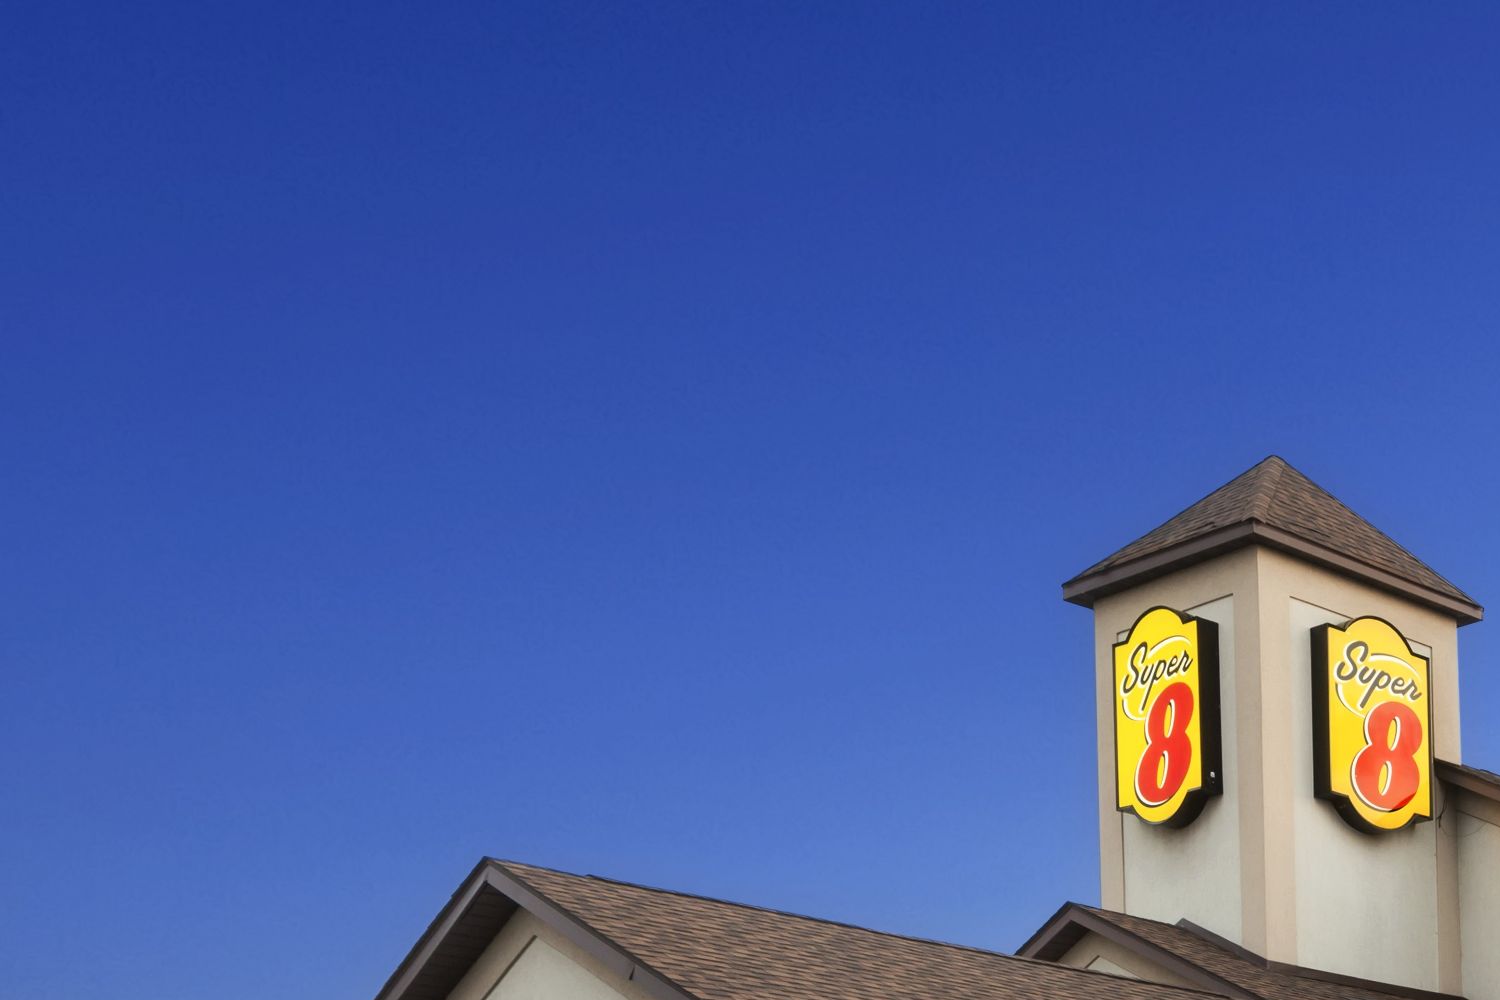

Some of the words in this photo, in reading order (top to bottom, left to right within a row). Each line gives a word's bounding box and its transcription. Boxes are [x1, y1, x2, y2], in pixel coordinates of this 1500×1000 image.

[1123, 641, 1193, 711] Super
[1336, 640, 1422, 709] Super
[1135, 682, 1193, 805] 8
[1352, 701, 1422, 812] 8
